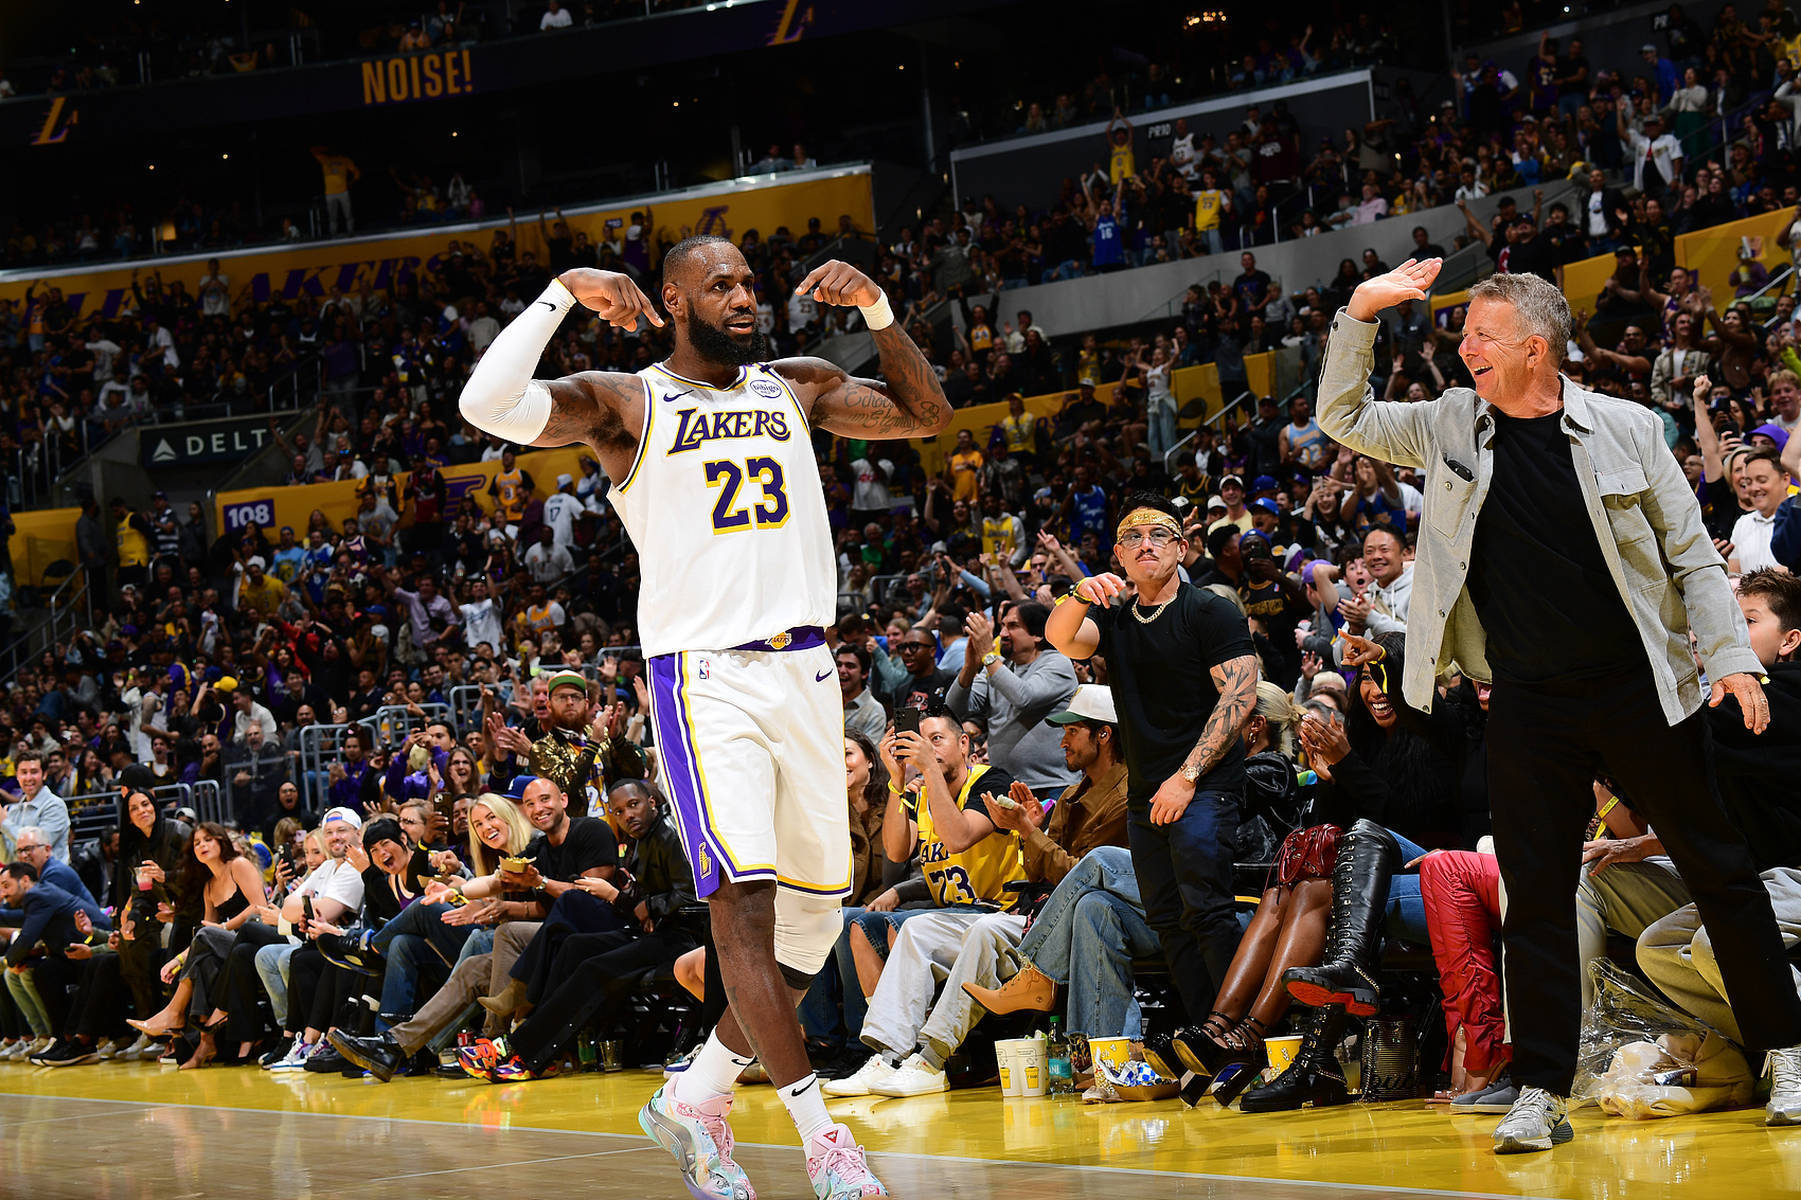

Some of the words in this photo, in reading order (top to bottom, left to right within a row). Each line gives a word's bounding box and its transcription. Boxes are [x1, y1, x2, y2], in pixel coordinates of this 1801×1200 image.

[362, 50, 473, 104] NOISE!
[230, 253, 452, 304] AKERS
[186, 426, 285, 456] DELT
[666, 406, 792, 457] LAKERS
[228, 503, 270, 528] 108
[550, 506, 561, 522] 17
[702, 455, 791, 536] 23
